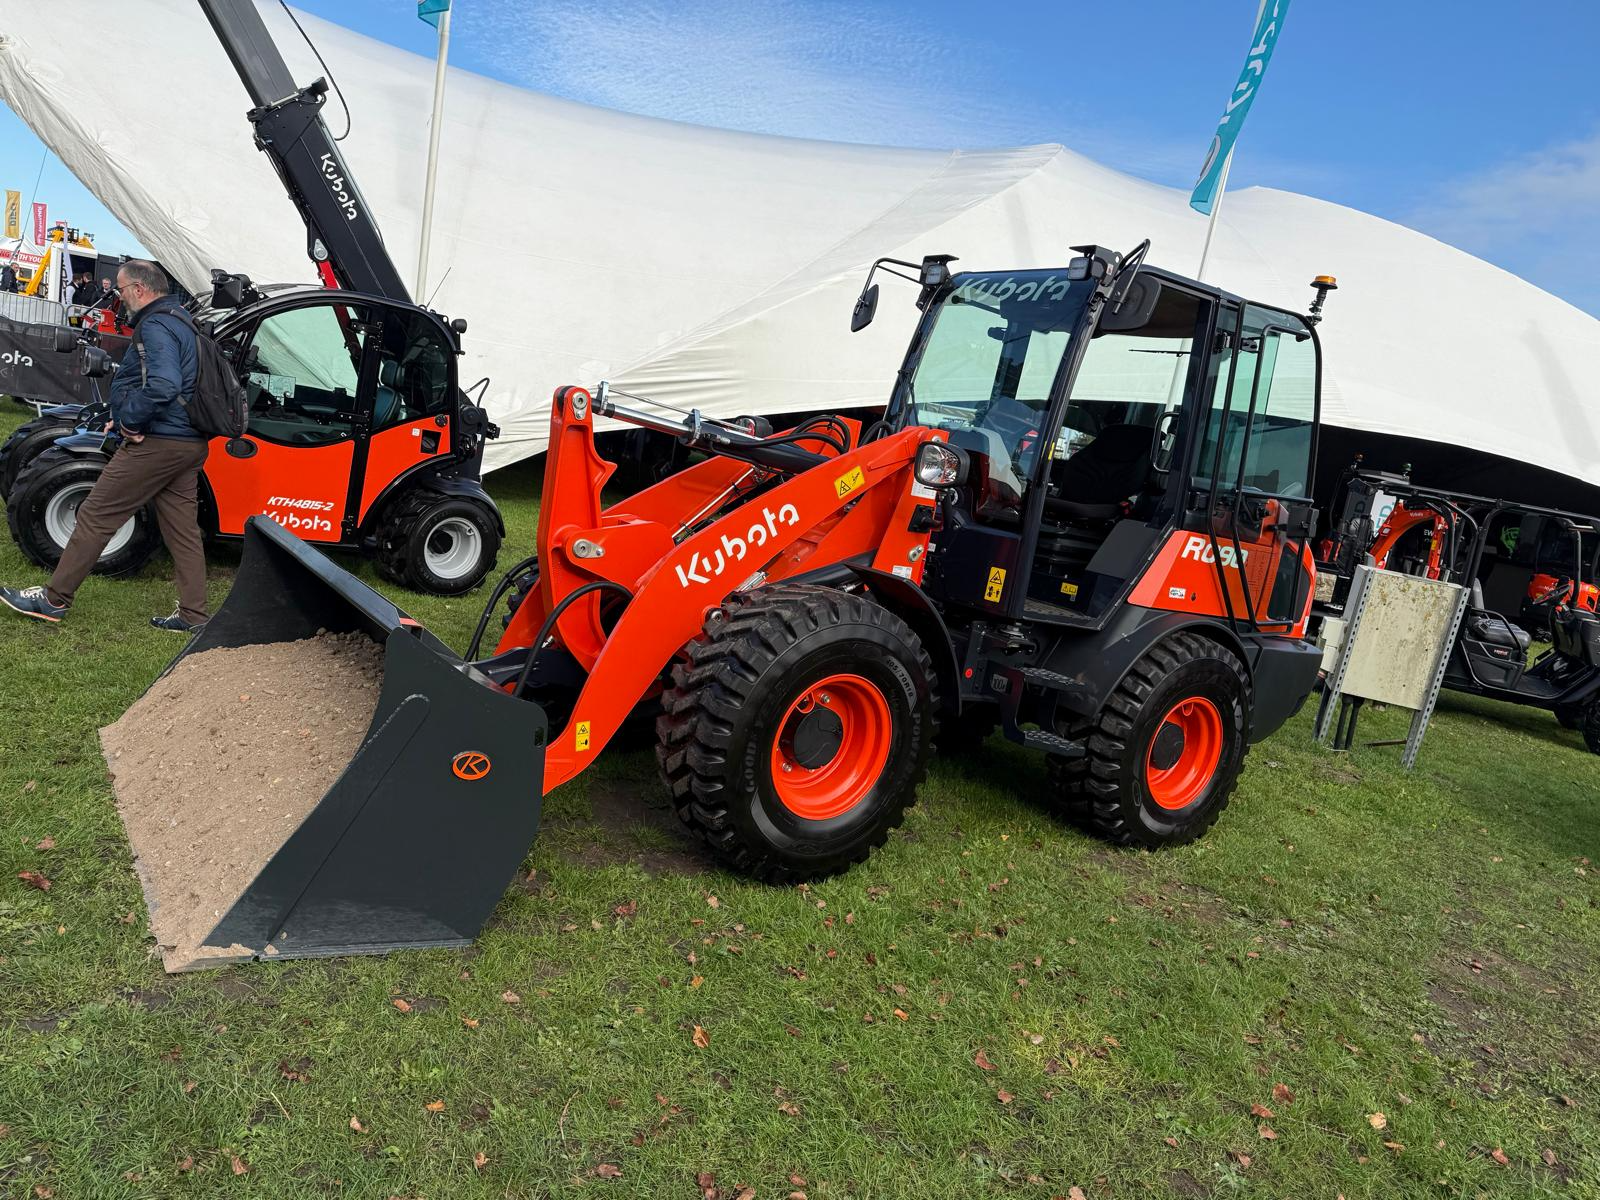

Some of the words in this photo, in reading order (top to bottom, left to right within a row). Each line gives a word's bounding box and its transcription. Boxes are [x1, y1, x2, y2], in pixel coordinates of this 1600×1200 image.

[320, 152, 357, 221] Kubota
[956, 275, 1071, 302] Kubota
[1, 349, 33, 367] ota
[267, 496, 335, 511] KTH4815-2
[674, 503, 800, 588] Kubota
[1181, 536, 1249, 569] R090
